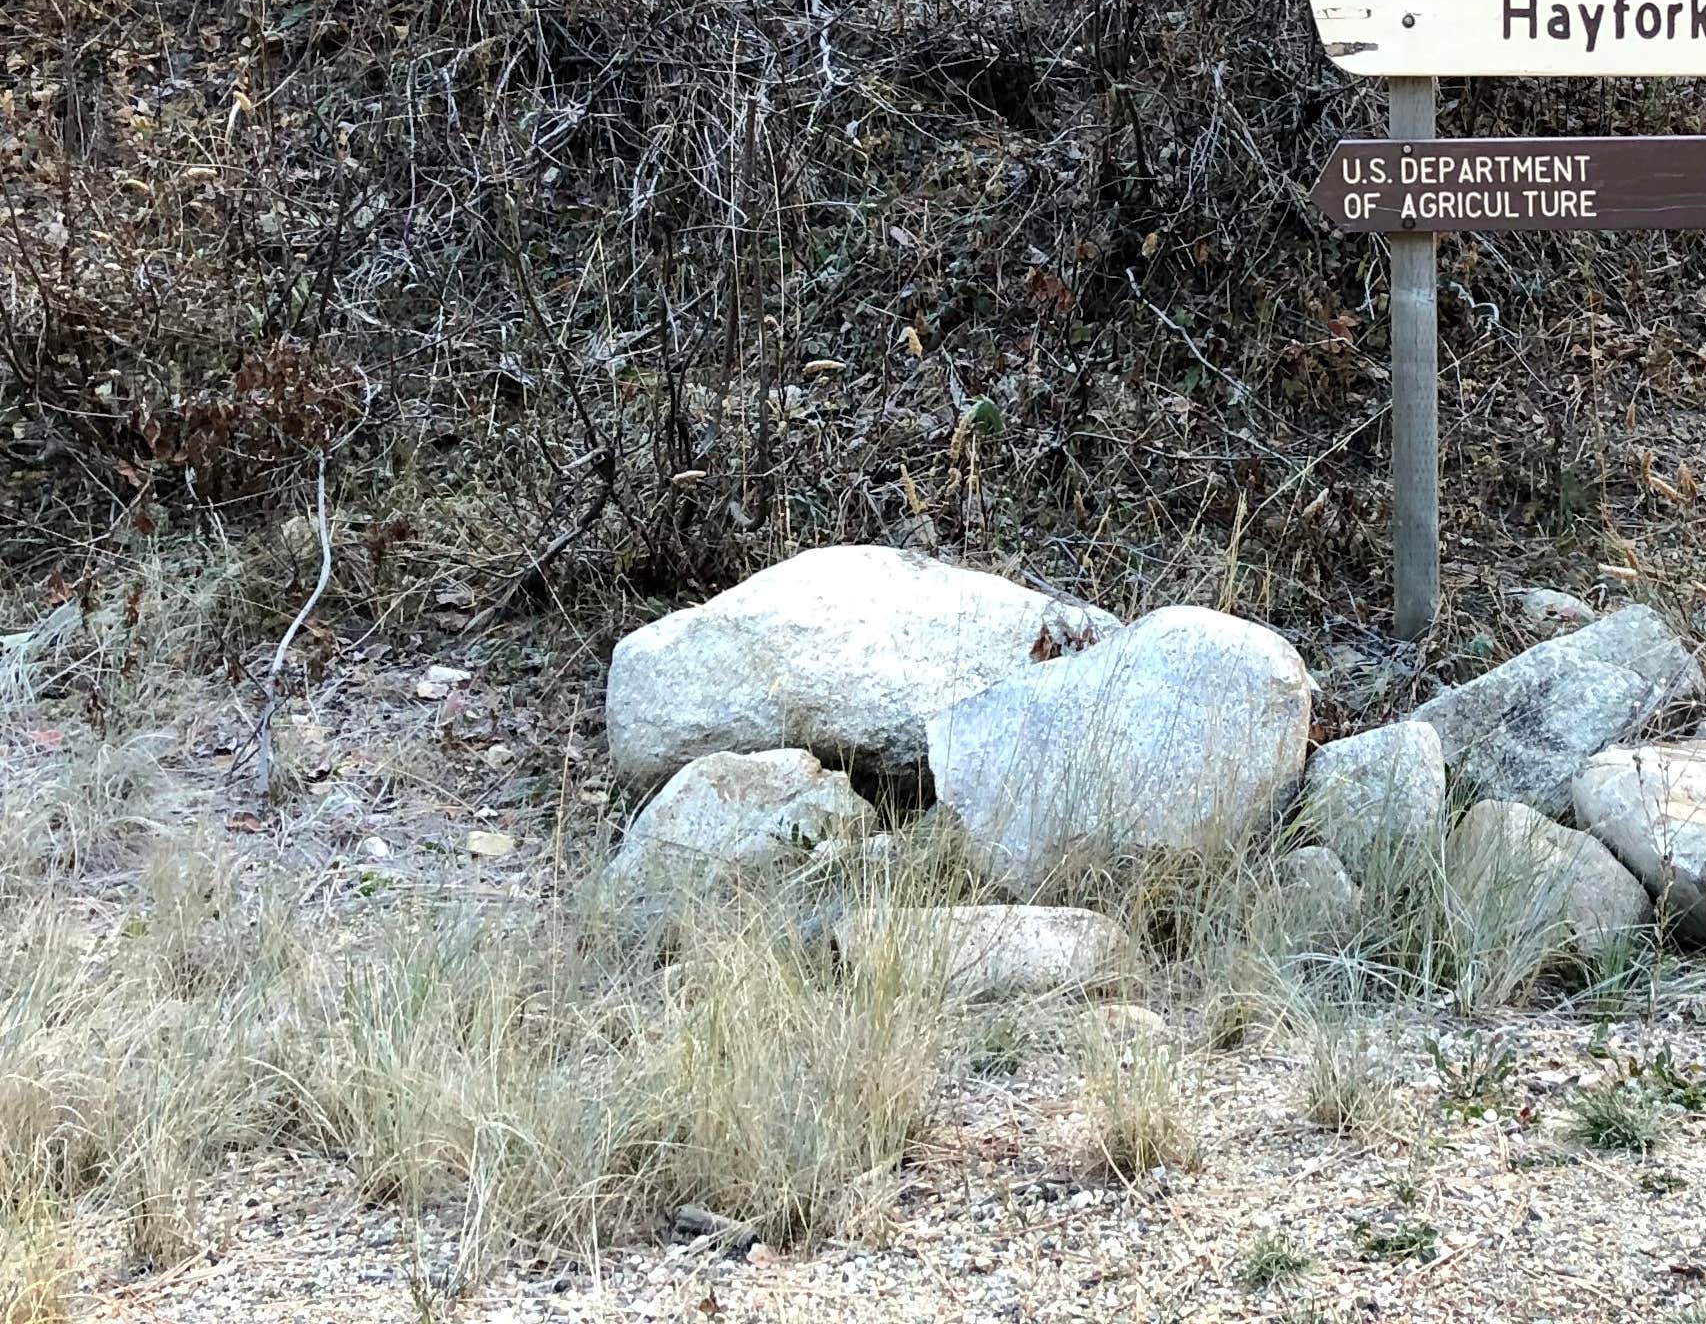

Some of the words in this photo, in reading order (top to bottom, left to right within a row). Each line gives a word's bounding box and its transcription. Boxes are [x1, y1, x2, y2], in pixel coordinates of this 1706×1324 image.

[1342, 155, 1393, 185] U.S.
[1400, 154, 1592, 185] DEPARTMENT
[1343, 191, 1381, 220] OF
[1400, 190, 1598, 219] AGRICULTURE
